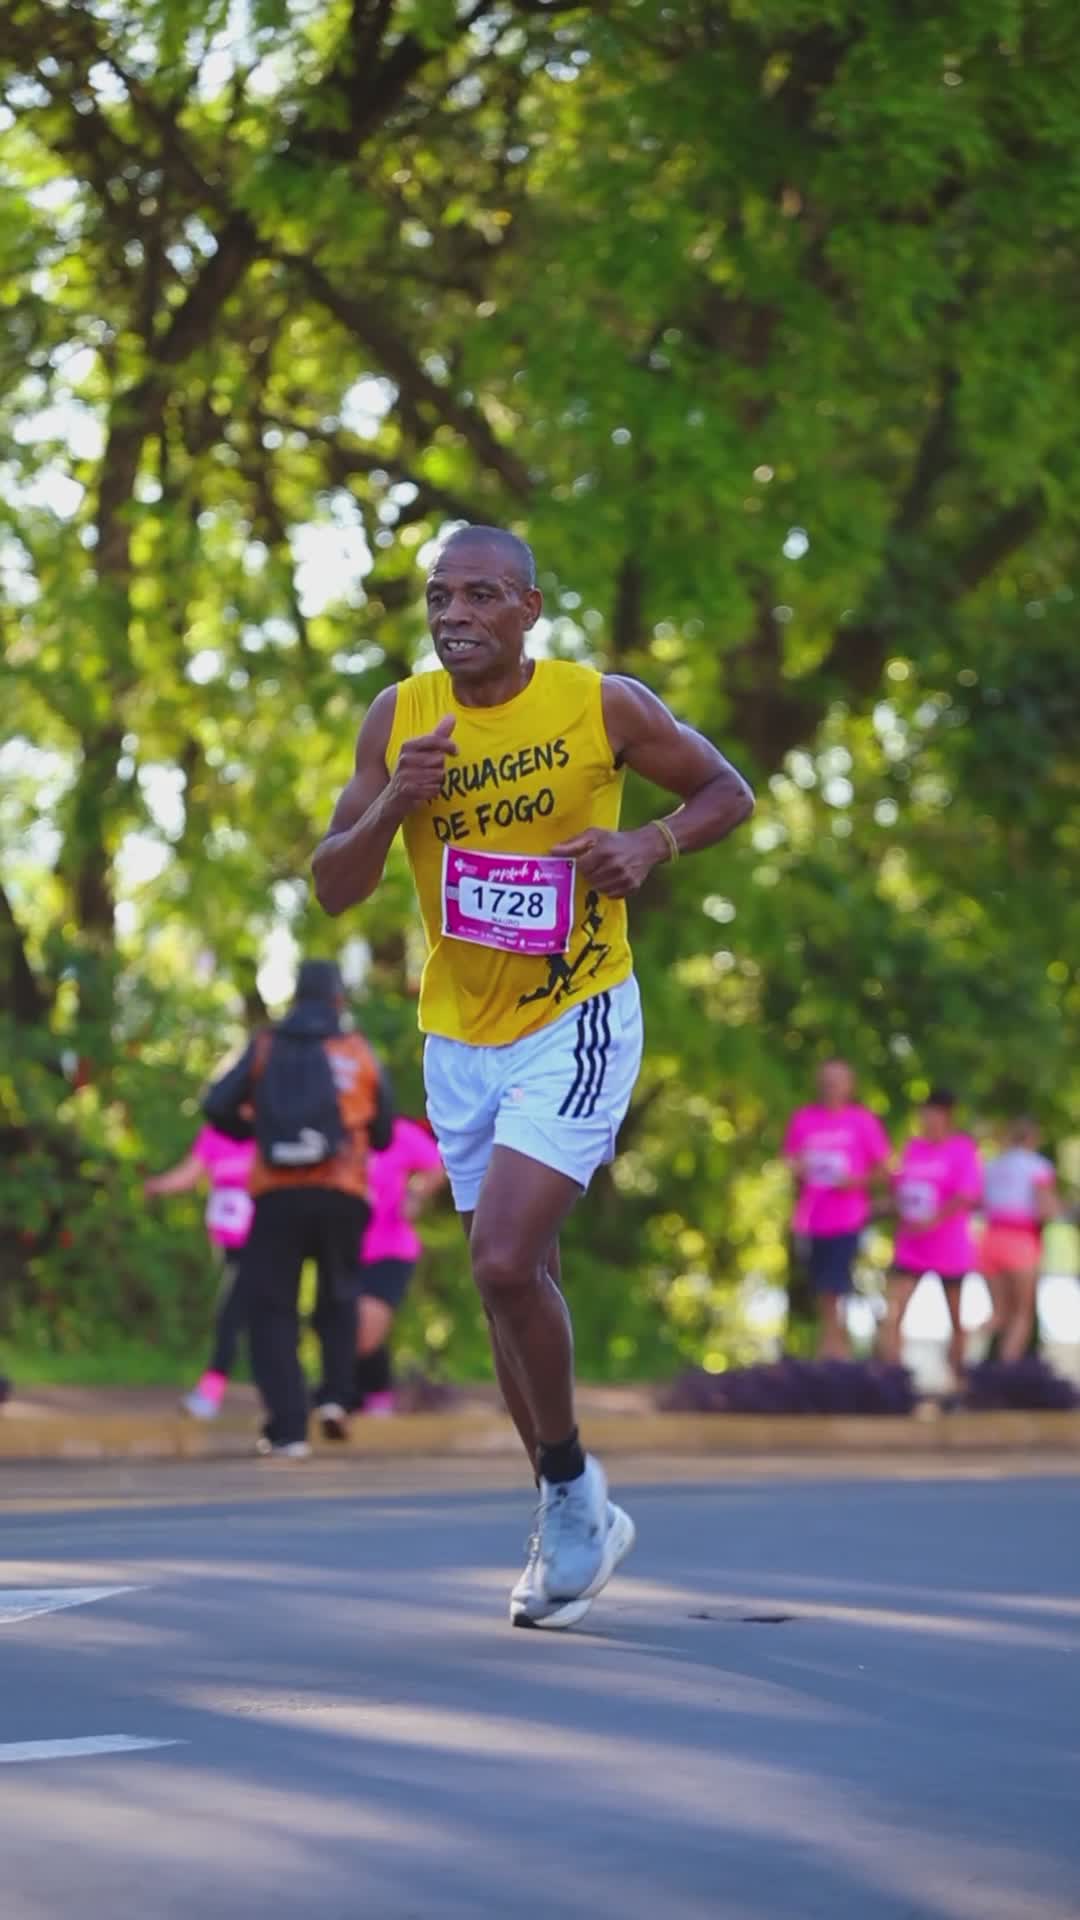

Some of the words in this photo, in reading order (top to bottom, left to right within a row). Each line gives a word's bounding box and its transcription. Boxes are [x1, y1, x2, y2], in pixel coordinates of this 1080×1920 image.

[433, 811, 469, 843] DE
[476, 788, 555, 836] FOGO
[472, 886, 543, 918] 1728
